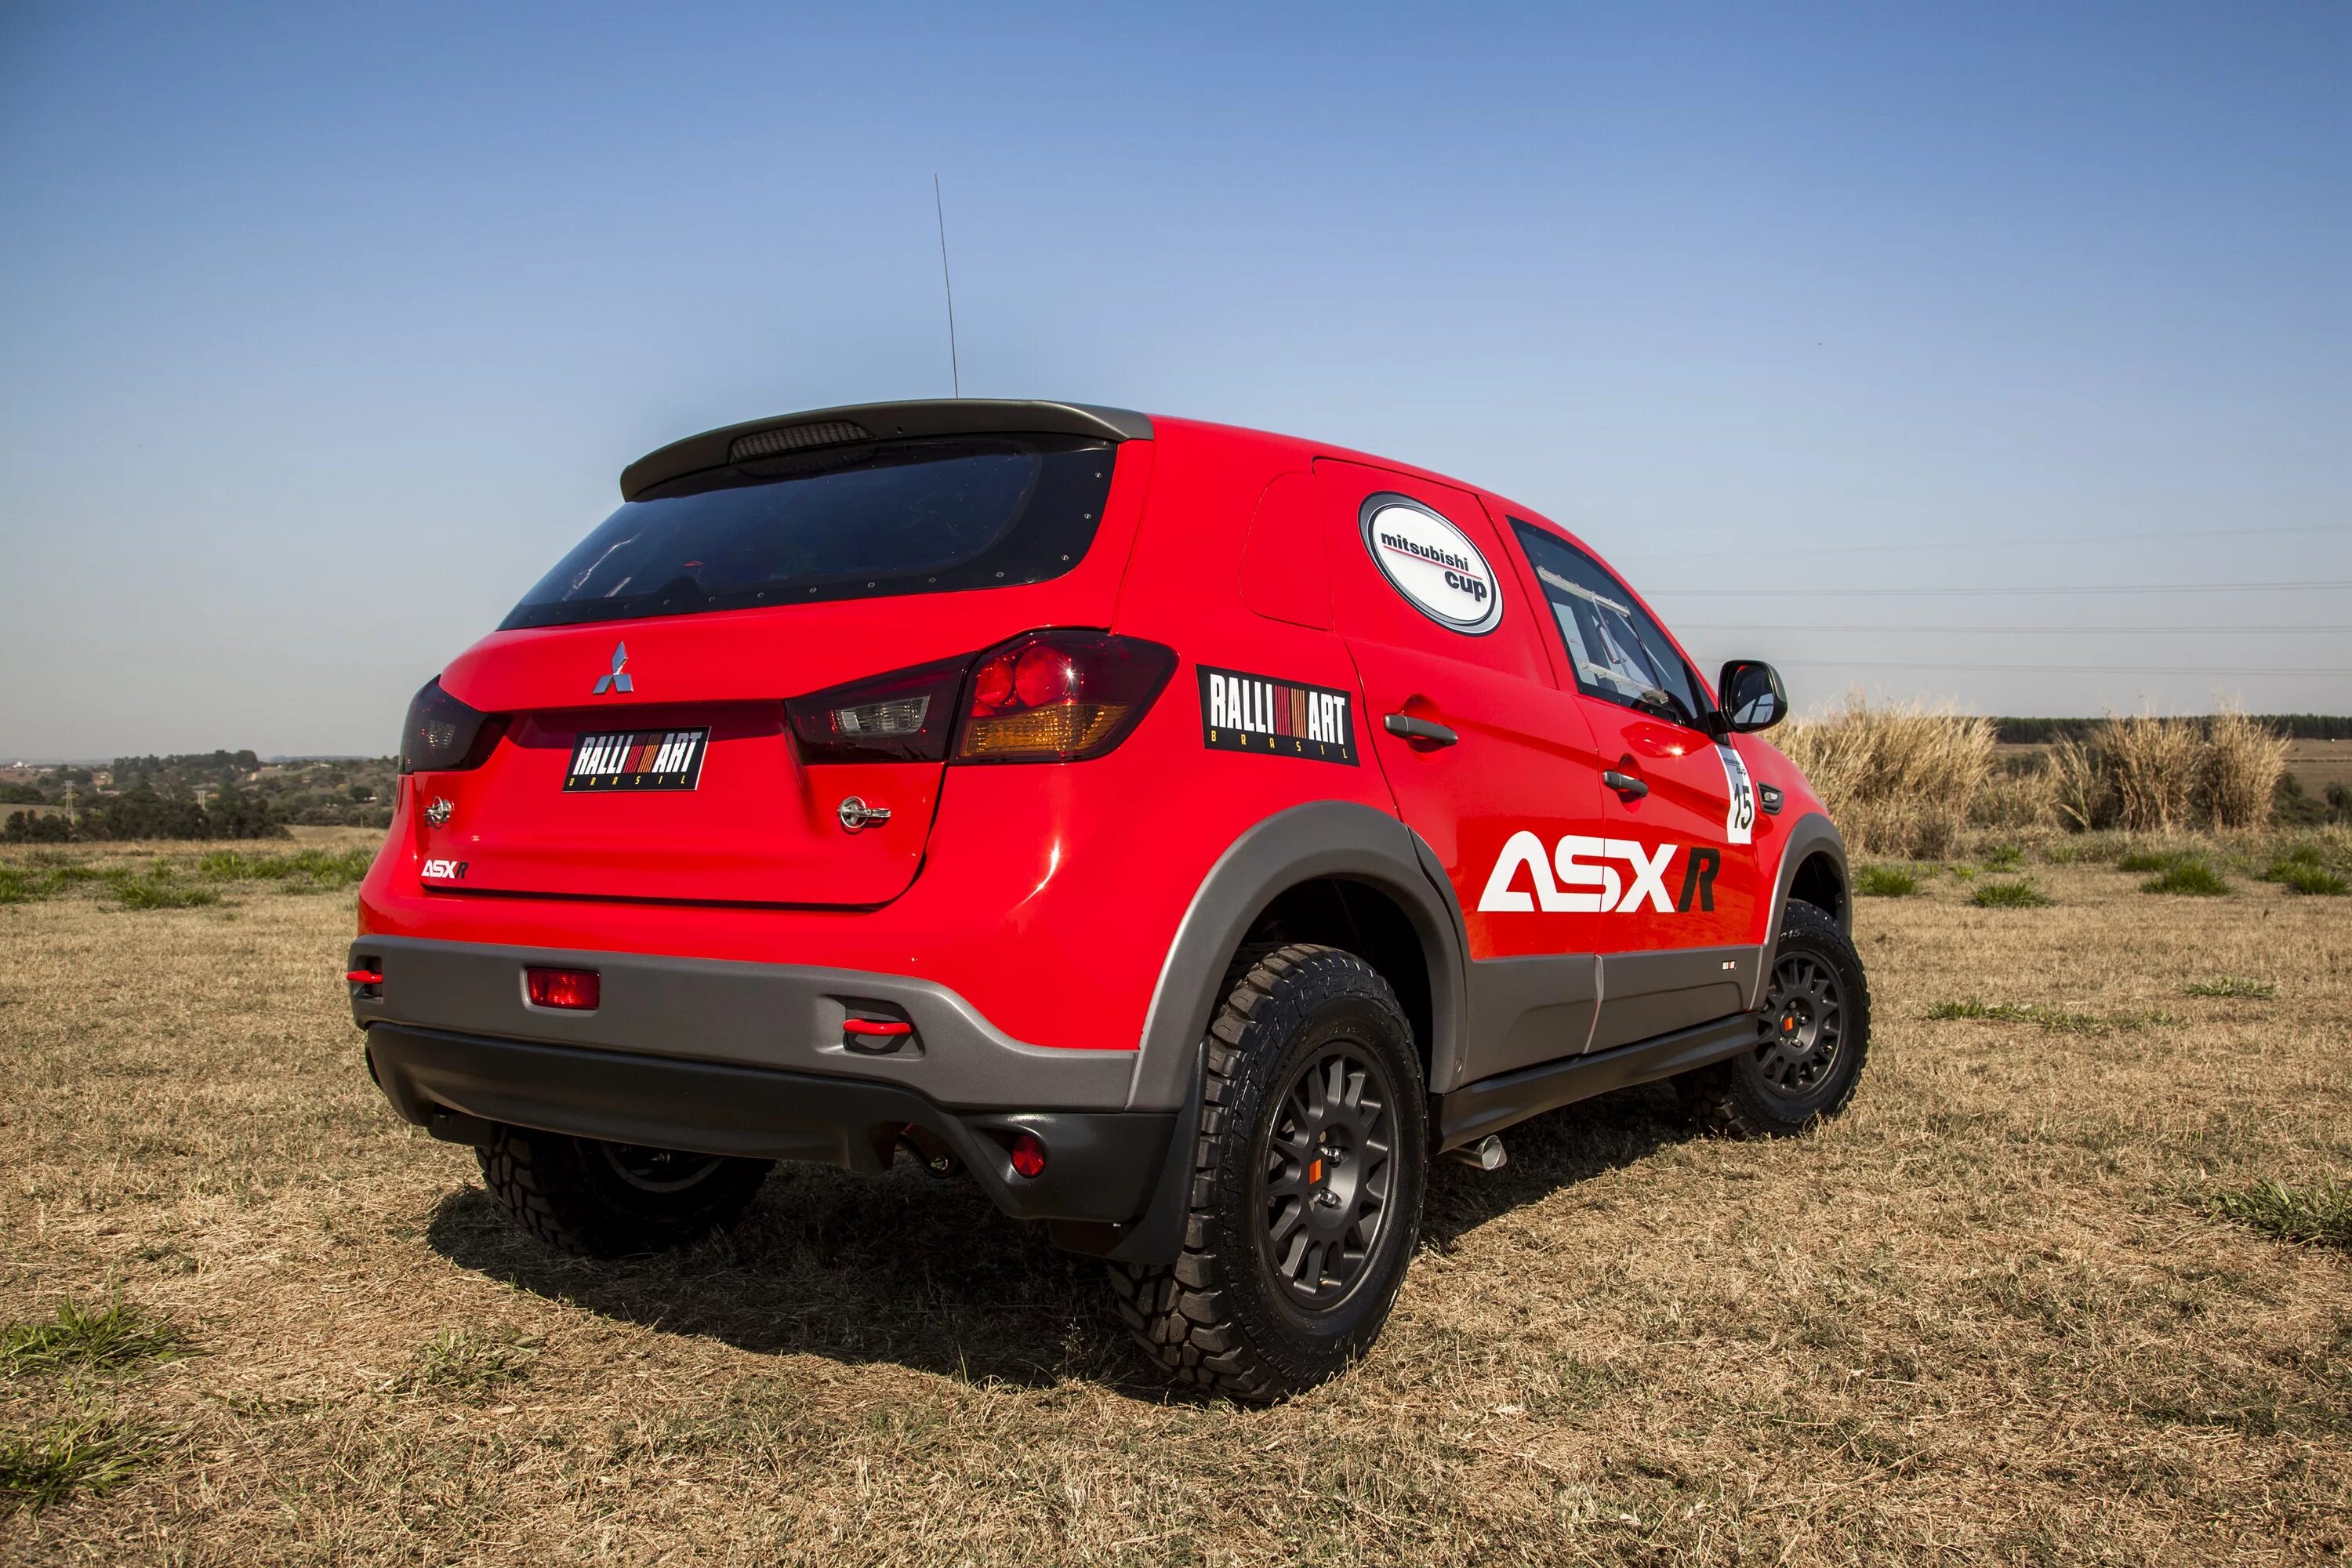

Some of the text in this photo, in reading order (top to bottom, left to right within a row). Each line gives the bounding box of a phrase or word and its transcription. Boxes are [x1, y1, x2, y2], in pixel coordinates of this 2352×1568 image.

[1381, 532, 1469, 572] mitsubishi
[1444, 571, 1486, 602] cup
[1211, 730, 1348, 758] BRASIL
[569, 775, 685, 786] BRASIL
[1733, 783, 1752, 829] 15
